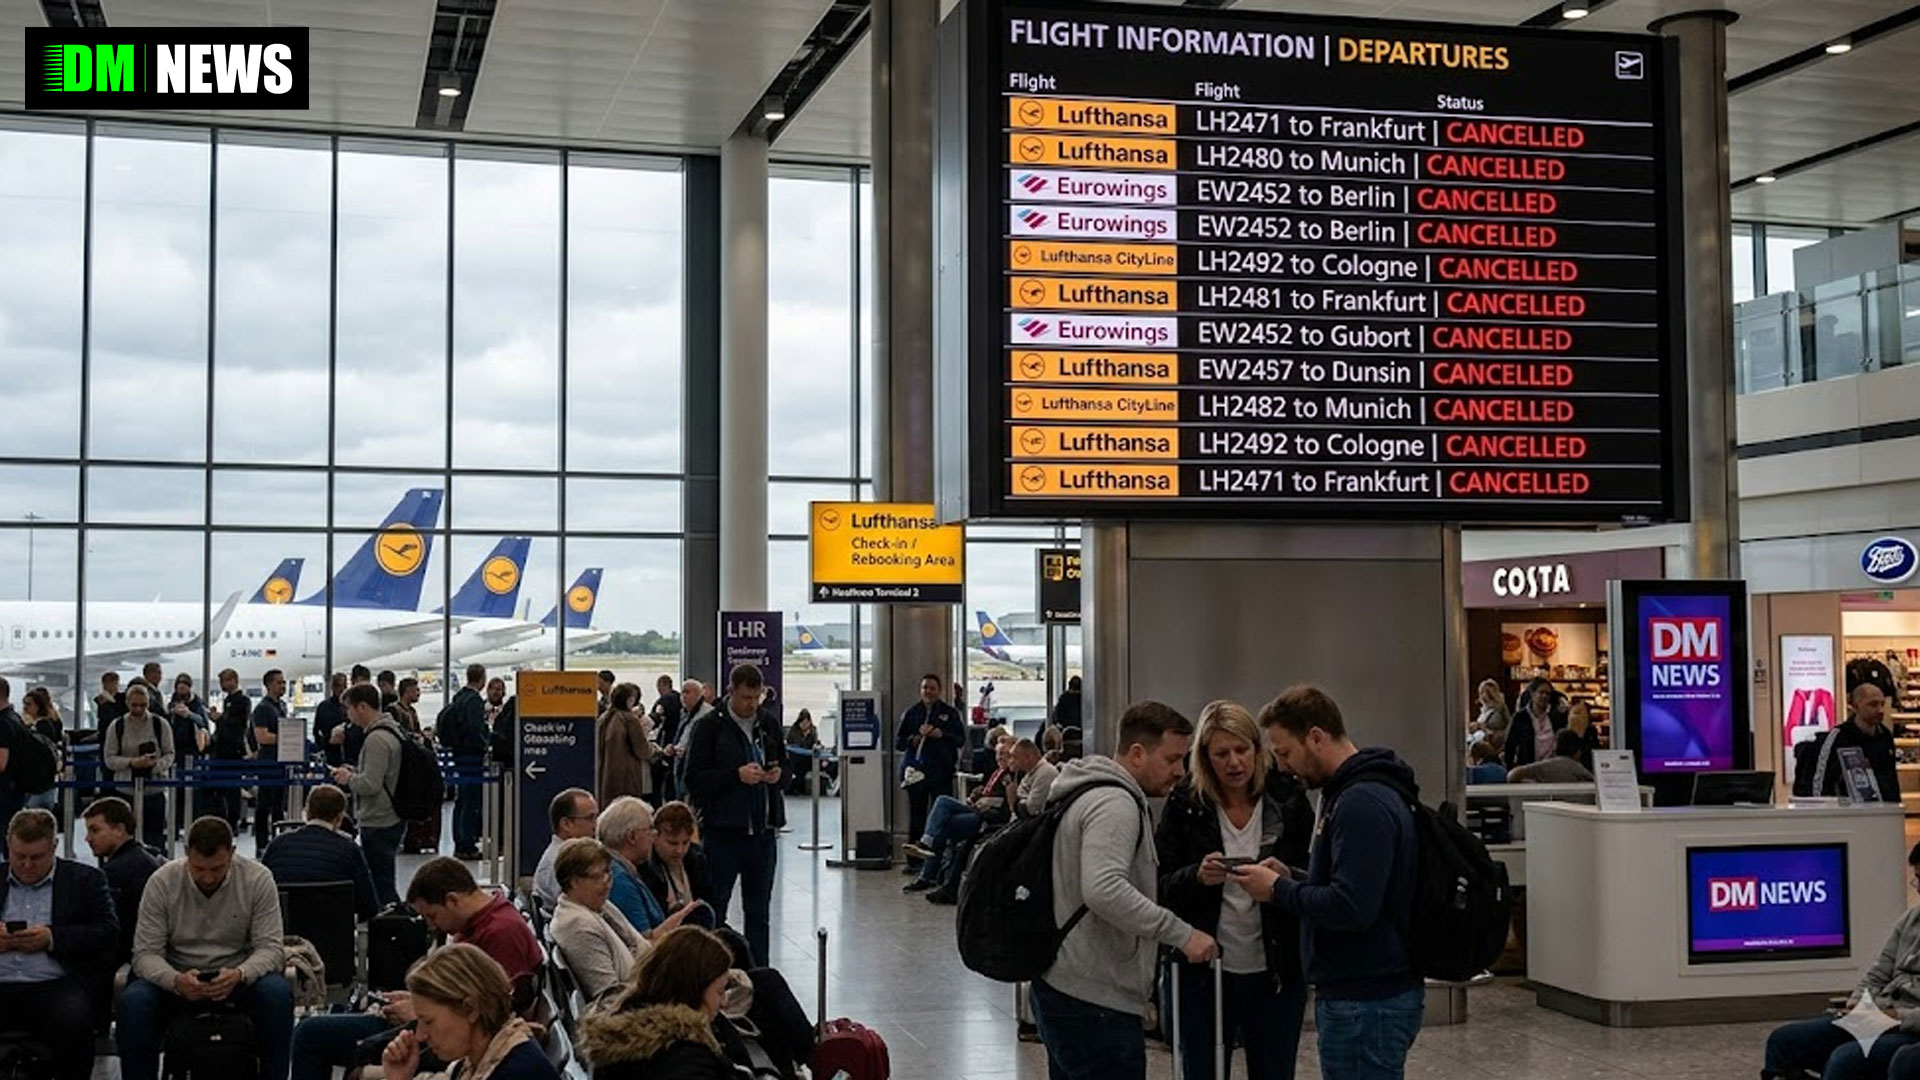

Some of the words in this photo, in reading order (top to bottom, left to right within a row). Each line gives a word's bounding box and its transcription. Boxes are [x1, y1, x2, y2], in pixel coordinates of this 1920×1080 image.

[1010, 19, 1109, 47] FLIGHT
[1117, 25, 1315, 59] INFORMATION
[1338, 37, 1510, 71] DEPARTURES
[1009, 72, 1056, 92] Flight
[1195, 82, 1241, 101] Flight
[1437, 94, 1484, 111] Status
[1058, 105, 1168, 128] Lufthansa
[1197, 110, 1280, 134] LH2471
[1289, 116, 1313, 136] to
[1320, 116, 1425, 142] Frankfurt
[1447, 122, 1584, 147] CANCELLED
[1058, 141, 1168, 164] Lufthansa
[1198, 145, 1283, 168] LH2480
[1290, 151, 1313, 170] to
[1321, 150, 1405, 174] Munich
[1427, 155, 1565, 180] CANCELLED
[1057, 177, 1168, 203] Eurowings
[1198, 180, 1291, 204] EW2452
[1299, 186, 1322, 206] to
[1330, 185, 1395, 208] Berlin
[1418, 189, 1556, 213] CANCELLED
[1057, 212, 1168, 238] Eurowings
[1198, 215, 1292, 239] EW2452
[1299, 221, 1322, 240] to
[1330, 220, 1395, 243] Berlin
[1418, 223, 1556, 247] CANCELLED
[1041, 250, 1112, 265] Lufthansa
[1116, 251, 1174, 268] CityLine
[1199, 251, 1284, 274] LH2492
[1290, 255, 1314, 275] to
[1322, 253, 1417, 282] Cologne
[1439, 258, 1577, 282] CANCELLED
[1058, 284, 1169, 305] Lufthansa
[1199, 286, 1281, 309] LH2481
[1290, 290, 1315, 310] to
[1322, 289, 1426, 313] Frankfurt
[1447, 292, 1585, 316] CANCELLED
[1058, 320, 1169, 345] Eurowings
[1199, 322, 1292, 345] EW2452
[1300, 326, 1324, 346] to
[1331, 325, 1411, 348] Gubort
[1433, 327, 1572, 350] CANCELLED
[1059, 357, 1169, 378] Lufthansa
[1199, 359, 1293, 382] EW2457
[1301, 361, 1325, 382] to
[1332, 361, 1411, 384] Dunsin
[1433, 363, 1573, 387] CANCELLED
[1042, 397, 1113, 410] Lufthansa
[1117, 398, 1175, 414] CityLine
[1200, 395, 1286, 418] LH2482
[1293, 399, 1317, 419] to
[1325, 396, 1411, 420] Munich
[1434, 399, 1573, 422] CANCELLED
[1059, 432, 1170, 452] Lufthansa
[1200, 431, 1287, 455] LH2492
[1294, 435, 1319, 455] to
[1327, 434, 1424, 462] Cologne
[1446, 435, 1586, 459] CANCELLED
[1059, 469, 1170, 490] Lufthansa
[1200, 469, 1284, 492] LH2471
[1291, 472, 1316, 492] to
[1324, 470, 1429, 494] Frankfurt
[1450, 472, 1589, 494] CANCELLED
[851, 537, 908, 549] Check-in
[851, 553, 922, 569] Rebooking
[925, 554, 956, 567] Area
[1493, 564, 1571, 599] COSTA
[727, 621, 767, 638] LHR
[1653, 622, 1718, 658] DM
[1652, 664, 1721, 687] NEWS
[1711, 882, 1756, 908] DM
[1761, 880, 1828, 905] NEWS
